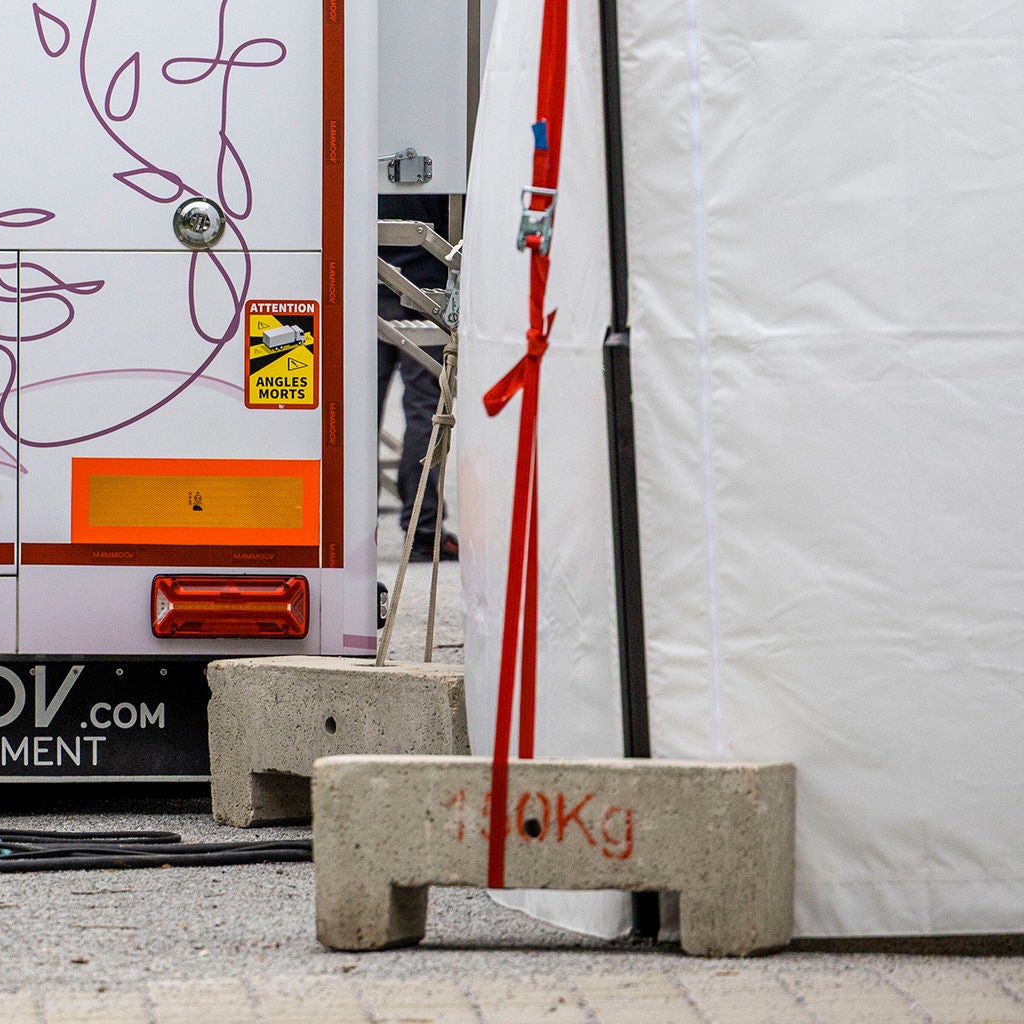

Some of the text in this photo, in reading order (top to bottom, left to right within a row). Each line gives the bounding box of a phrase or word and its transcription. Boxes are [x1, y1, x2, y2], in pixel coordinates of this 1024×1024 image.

[249, 303, 315, 314] ATTENTION
[255, 376, 308, 388] ANGLES
[259, 388, 306, 400] MORTS
[92, 551, 135, 559] MAMMOOV
[233, 552, 276, 560] MAMMOOV
